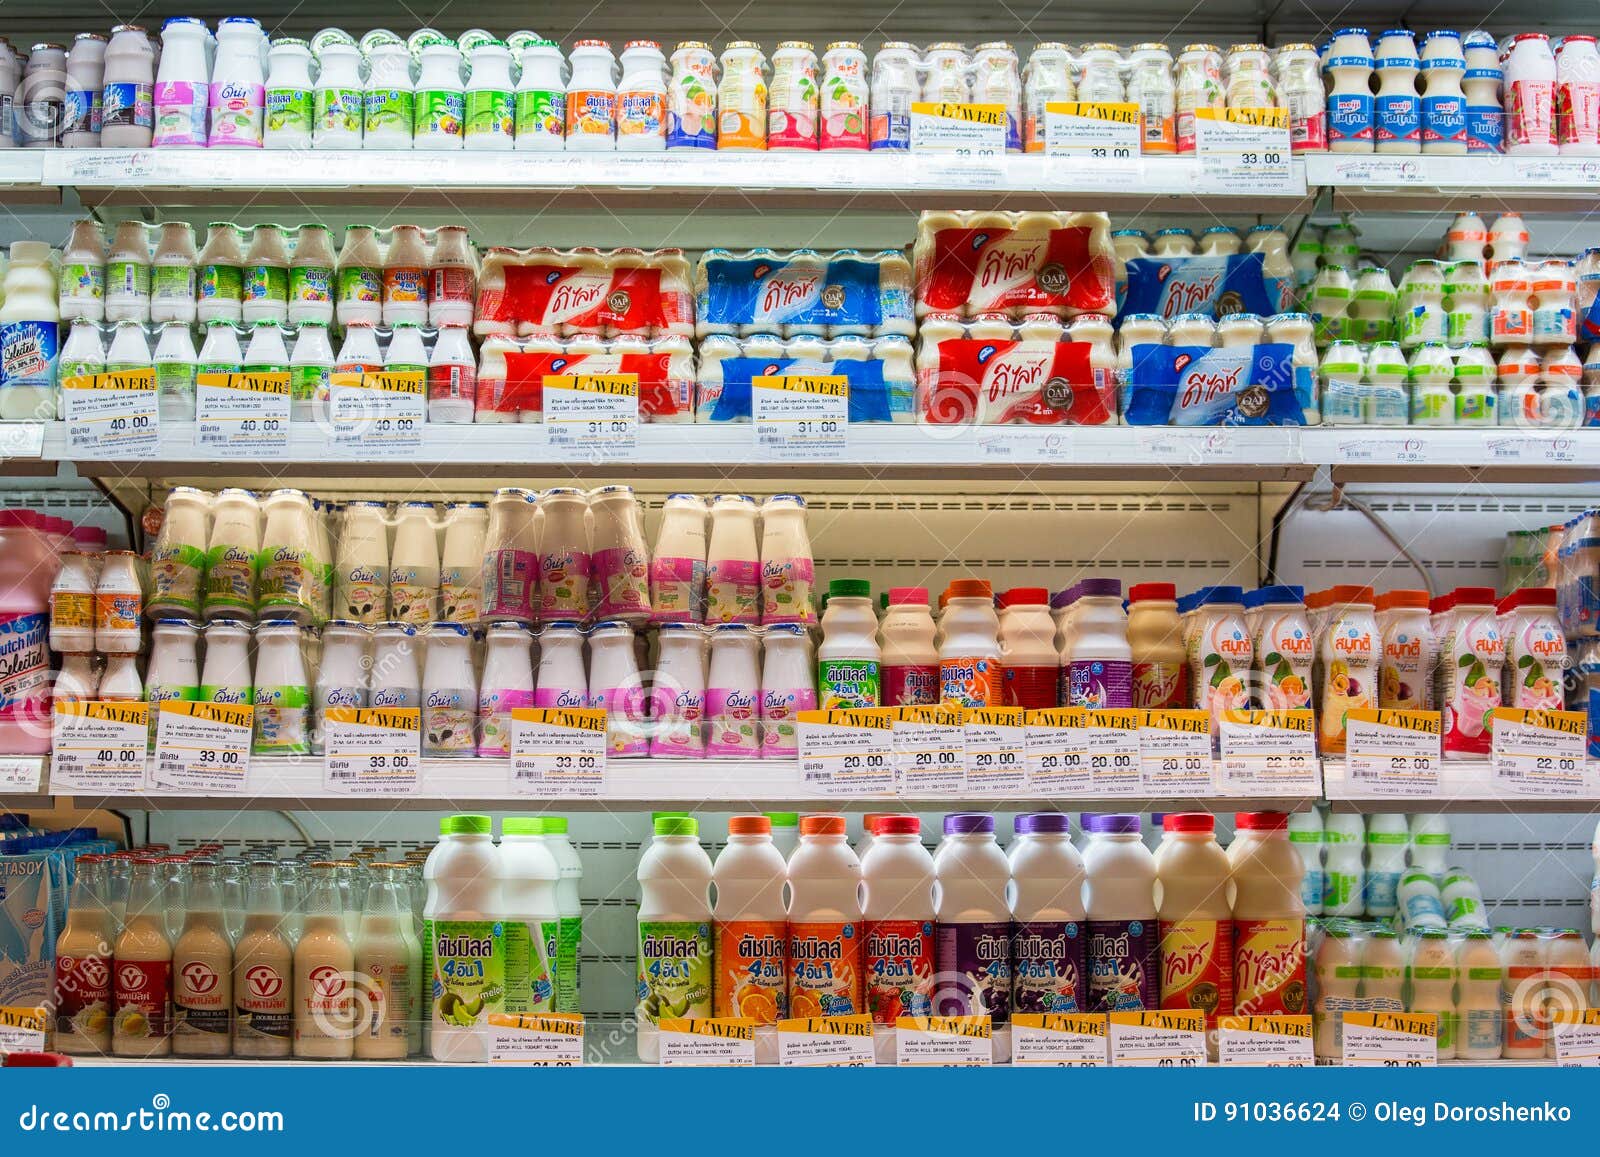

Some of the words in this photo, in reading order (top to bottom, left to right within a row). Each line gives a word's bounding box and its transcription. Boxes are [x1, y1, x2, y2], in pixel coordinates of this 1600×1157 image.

[1338, 100, 1361, 110] meiji
[1388, 101, 1411, 111] meiji
[1435, 101, 1458, 111] meiji
[1242, 153, 1280, 164] 33.00
[981, 245, 1041, 288] ดีไลท์
[1041, 275, 1066, 284] OAP
[552, 283, 604, 313] ดีไลท์
[610, 298, 627, 307] OAP
[764, 276, 818, 313] ดีไลท์
[1027, 288, 1037, 299] 2
[1164, 275, 1219, 319] ดีไลท์
[93, 375, 149, 390] LOWER
[227, 374, 283, 394] LOWER
[574, 376, 630, 395] LOWER
[783, 376, 839, 395] LOWER
[989, 358, 1048, 403] ดีไลท์
[1181, 366, 1242, 409] ดีไลท์
[1047, 389, 1070, 398] OAP
[1034, 404, 1042, 415] 2
[110, 416, 148, 430] 40.00
[240, 419, 279, 431] 40.00
[375, 419, 413, 431] 40.00
[589, 421, 627, 433] 31.00
[798, 421, 837, 433] 31.00
[0, 636, 25, 656] utch
[1335, 632, 1371, 654] สมูทตี้
[1386, 637, 1421, 659] สมูทตี้
[827, 664, 867, 682] ดัชมิลล์
[85, 703, 140, 723] LOWER
[189, 703, 246, 726] LOWER
[356, 710, 412, 729] LOWER
[542, 710, 598, 730] LOWER
[828, 711, 884, 729] LOWER
[899, 708, 955, 726] LOWER
[1146, 711, 1201, 732] LOWER
[1377, 710, 1432, 733] LOWER
[97, 750, 135, 762] 40.00
[200, 751, 238, 763] 33.00
[370, 756, 408, 768] 33.00
[556, 756, 595, 768] 33.00
[844, 755, 883, 768] 20.00
[916, 752, 955, 765] 20.00
[976, 753, 1015, 766] 20.00
[1041, 754, 1080, 767] 20.00
[1091, 755, 1130, 768] 20.00
[1162, 758, 1201, 770] 20.00
[1266, 756, 1305, 768] 22.00
[1391, 757, 1430, 769] 22.00
[1536, 757, 1575, 769] 22.00
[438, 934, 493, 957] ดัชมิลล์
[643, 934, 699, 958] ดัชมิลล์
[790, 934, 842, 959] ดัชมิลล์
[867, 932, 923, 957] ดัชมิลล์
[1192, 993, 1217, 1003] OAP
[517, 1014, 575, 1035] LOWER
[688, 1019, 746, 1039] LOWER
[807, 1018, 864, 1035] LOWER
[1042, 1014, 1099, 1035] LOWER
[1140, 1012, 1197, 1031] LOWER
[1247, 1016, 1304, 1036] LOWER
[1372, 1013, 1429, 1036] LOWER
